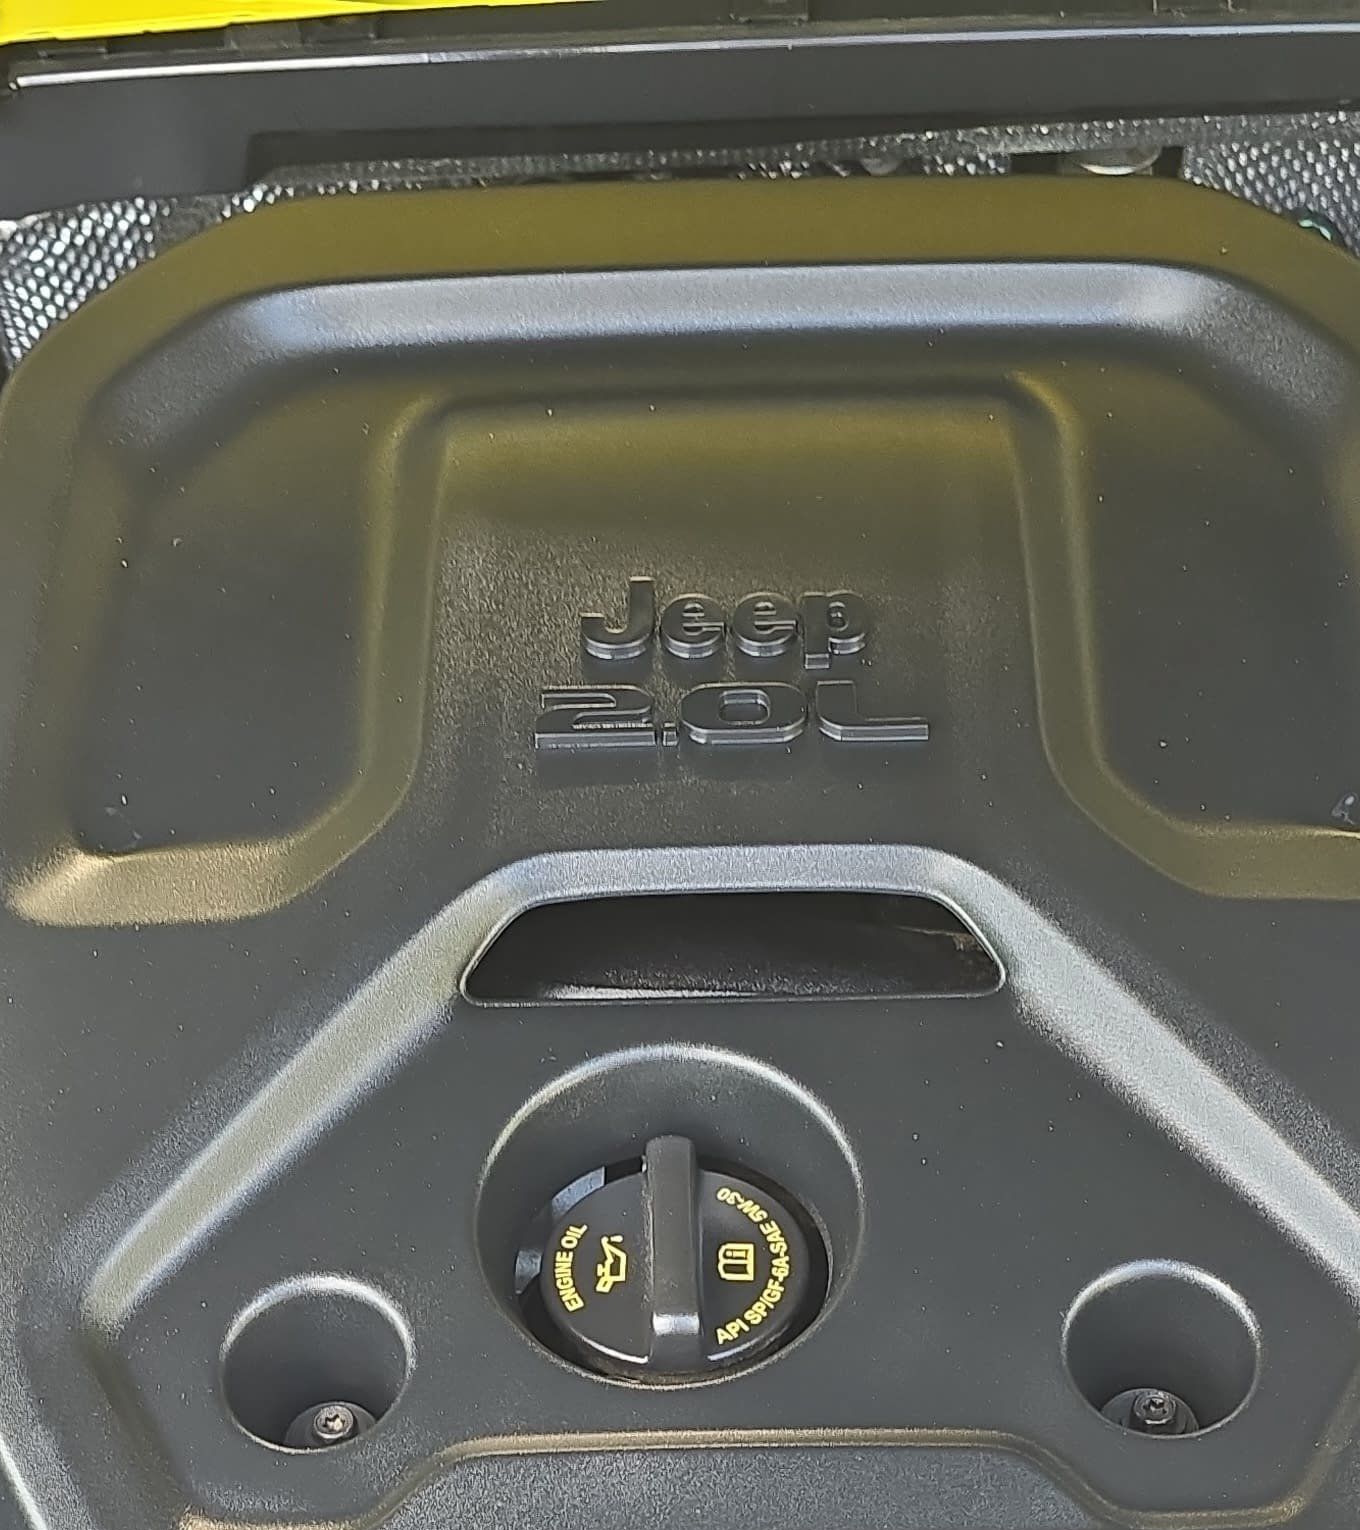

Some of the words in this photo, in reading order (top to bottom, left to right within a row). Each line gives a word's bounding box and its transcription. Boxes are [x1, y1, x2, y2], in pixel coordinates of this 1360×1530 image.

[579, 575, 870, 669] Jeep
[533, 679, 930, 750] 2.0L
[560, 1223, 589, 1250] OIL
[554, 1250, 585, 1313] ENGINE
[715, 1318, 750, 1346] API
